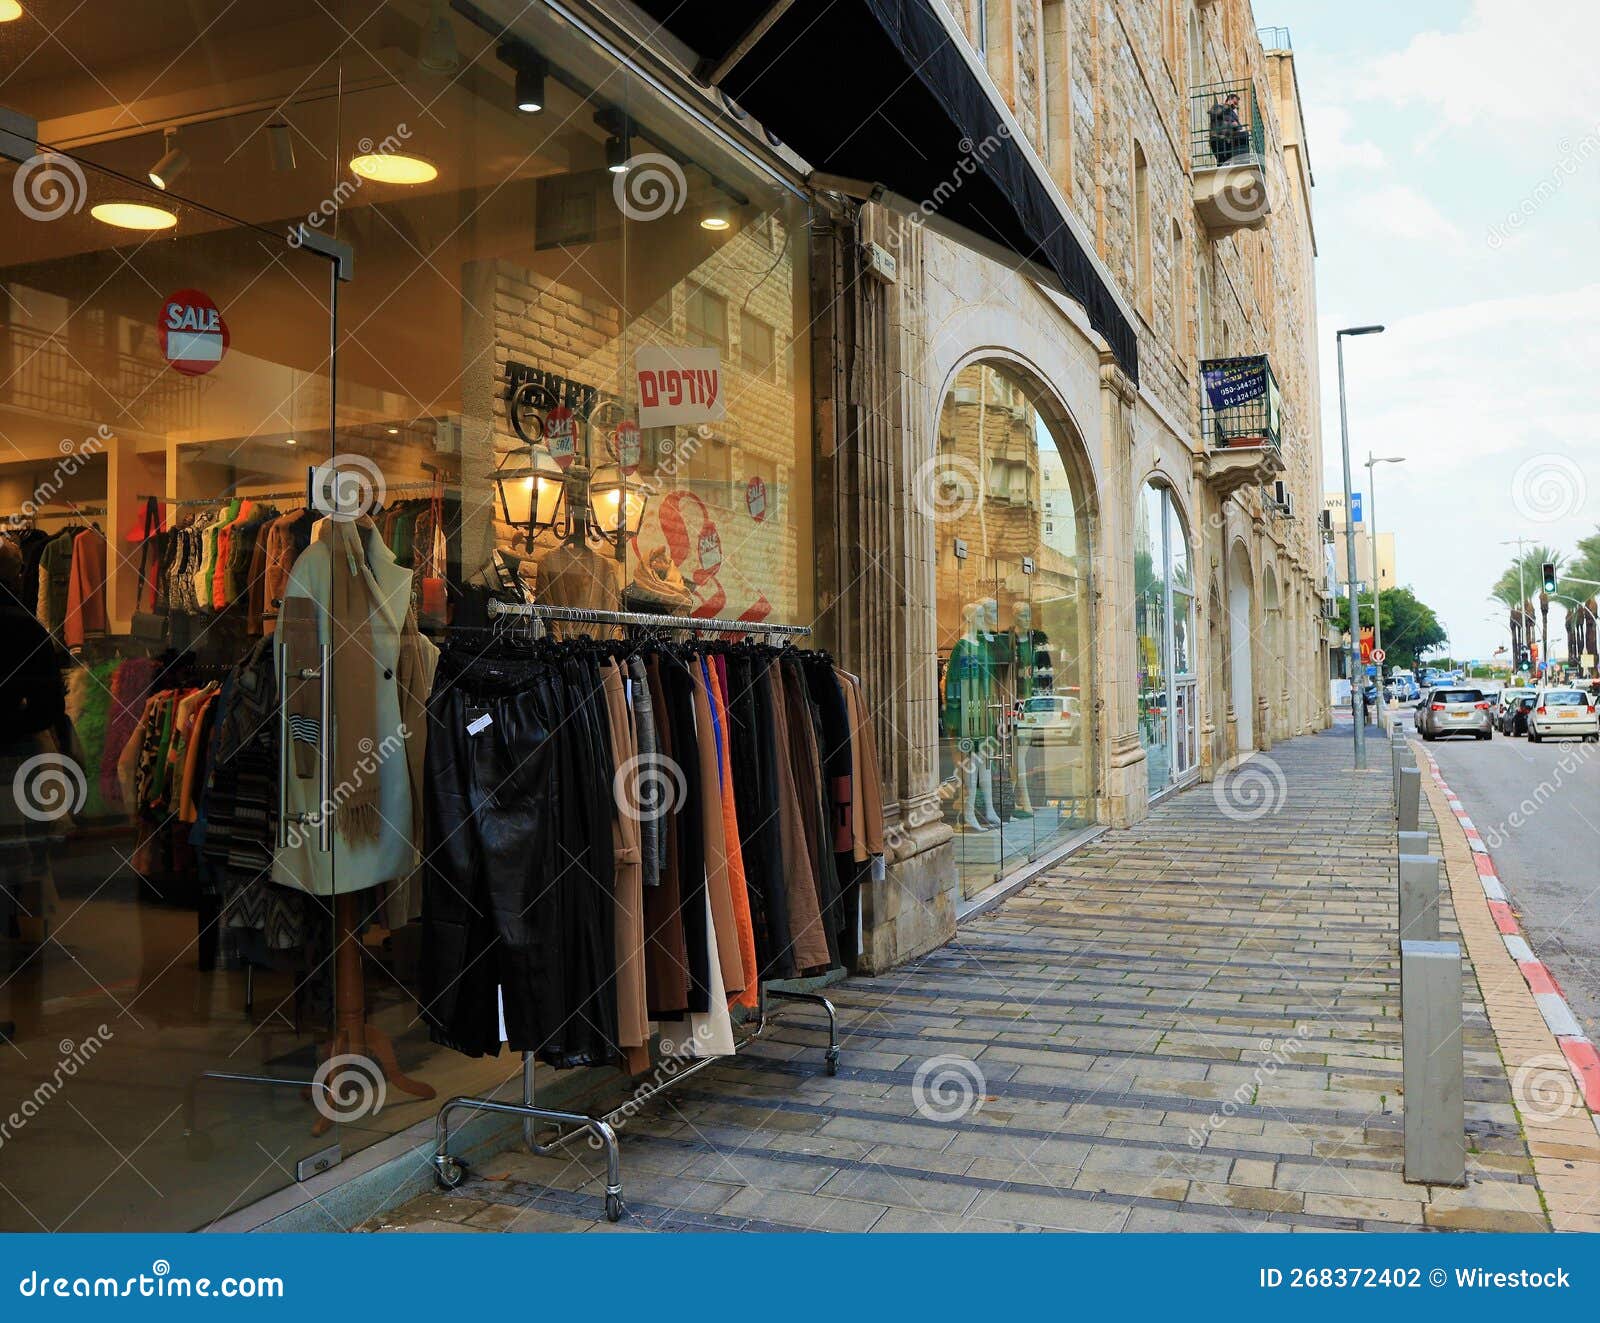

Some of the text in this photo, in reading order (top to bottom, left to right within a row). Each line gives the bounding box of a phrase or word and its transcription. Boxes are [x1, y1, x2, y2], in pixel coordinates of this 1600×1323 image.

[164, 302, 221, 331] SALE
[638, 369, 718, 409] עודפים
[547, 418, 573, 437] SALE
